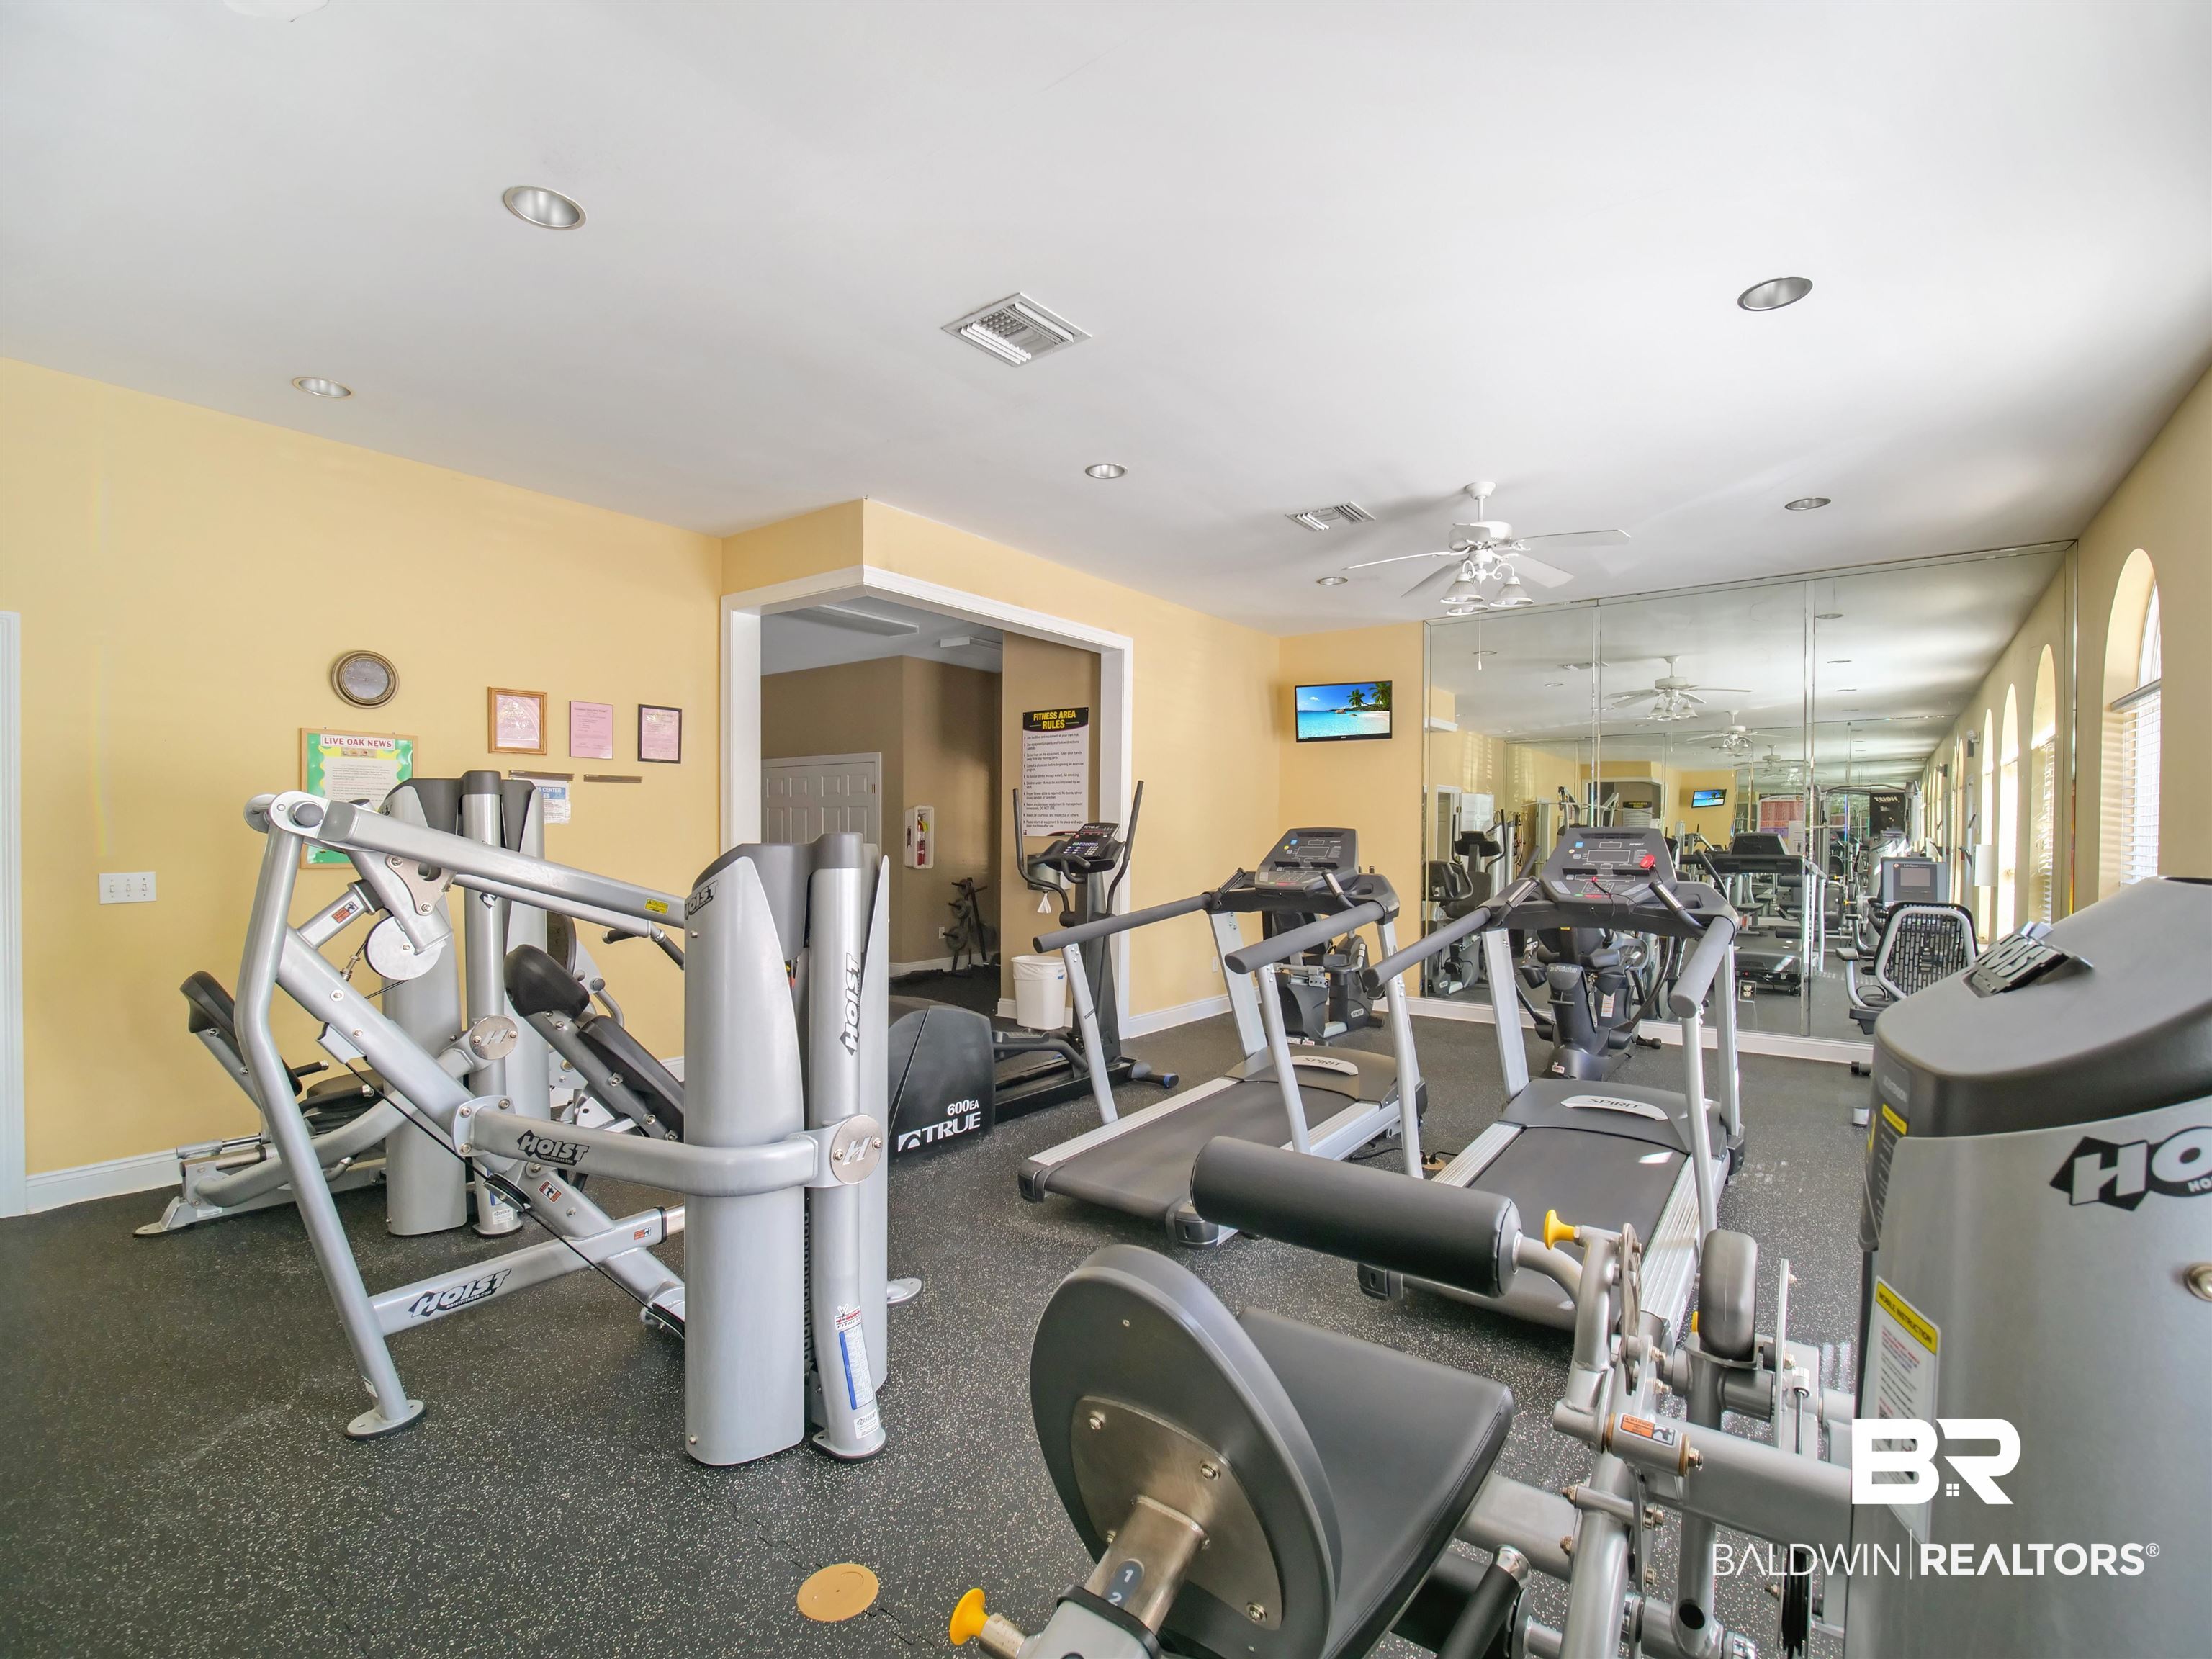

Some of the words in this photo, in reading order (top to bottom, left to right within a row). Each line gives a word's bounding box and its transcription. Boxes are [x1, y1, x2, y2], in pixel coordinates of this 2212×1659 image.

[1033, 711, 1057, 721] FITNESS
[1058, 710, 1076, 719] AREA
[1042, 719, 1065, 729] RULES
[845, 953, 859, 1052] HOIST
[1303, 1057, 1343, 1066] SPIRIT
[947, 1099, 979, 1116] 600EA
[1590, 1098, 1642, 1109] SPIRIT
[922, 1112, 981, 1143] TRUE
[518, 1135, 590, 1162] HOIST
[411, 1268, 512, 1318] HOIST
[446, 1290, 492, 1309] HOISTFITNESS.COM
[1879, 1291, 1896, 1313] MOBILE
[1896, 1308, 1933, 1344] INSTRUCTION
[1124, 1569, 1134, 1583] 1
[1108, 1591, 1123, 1606] 2
